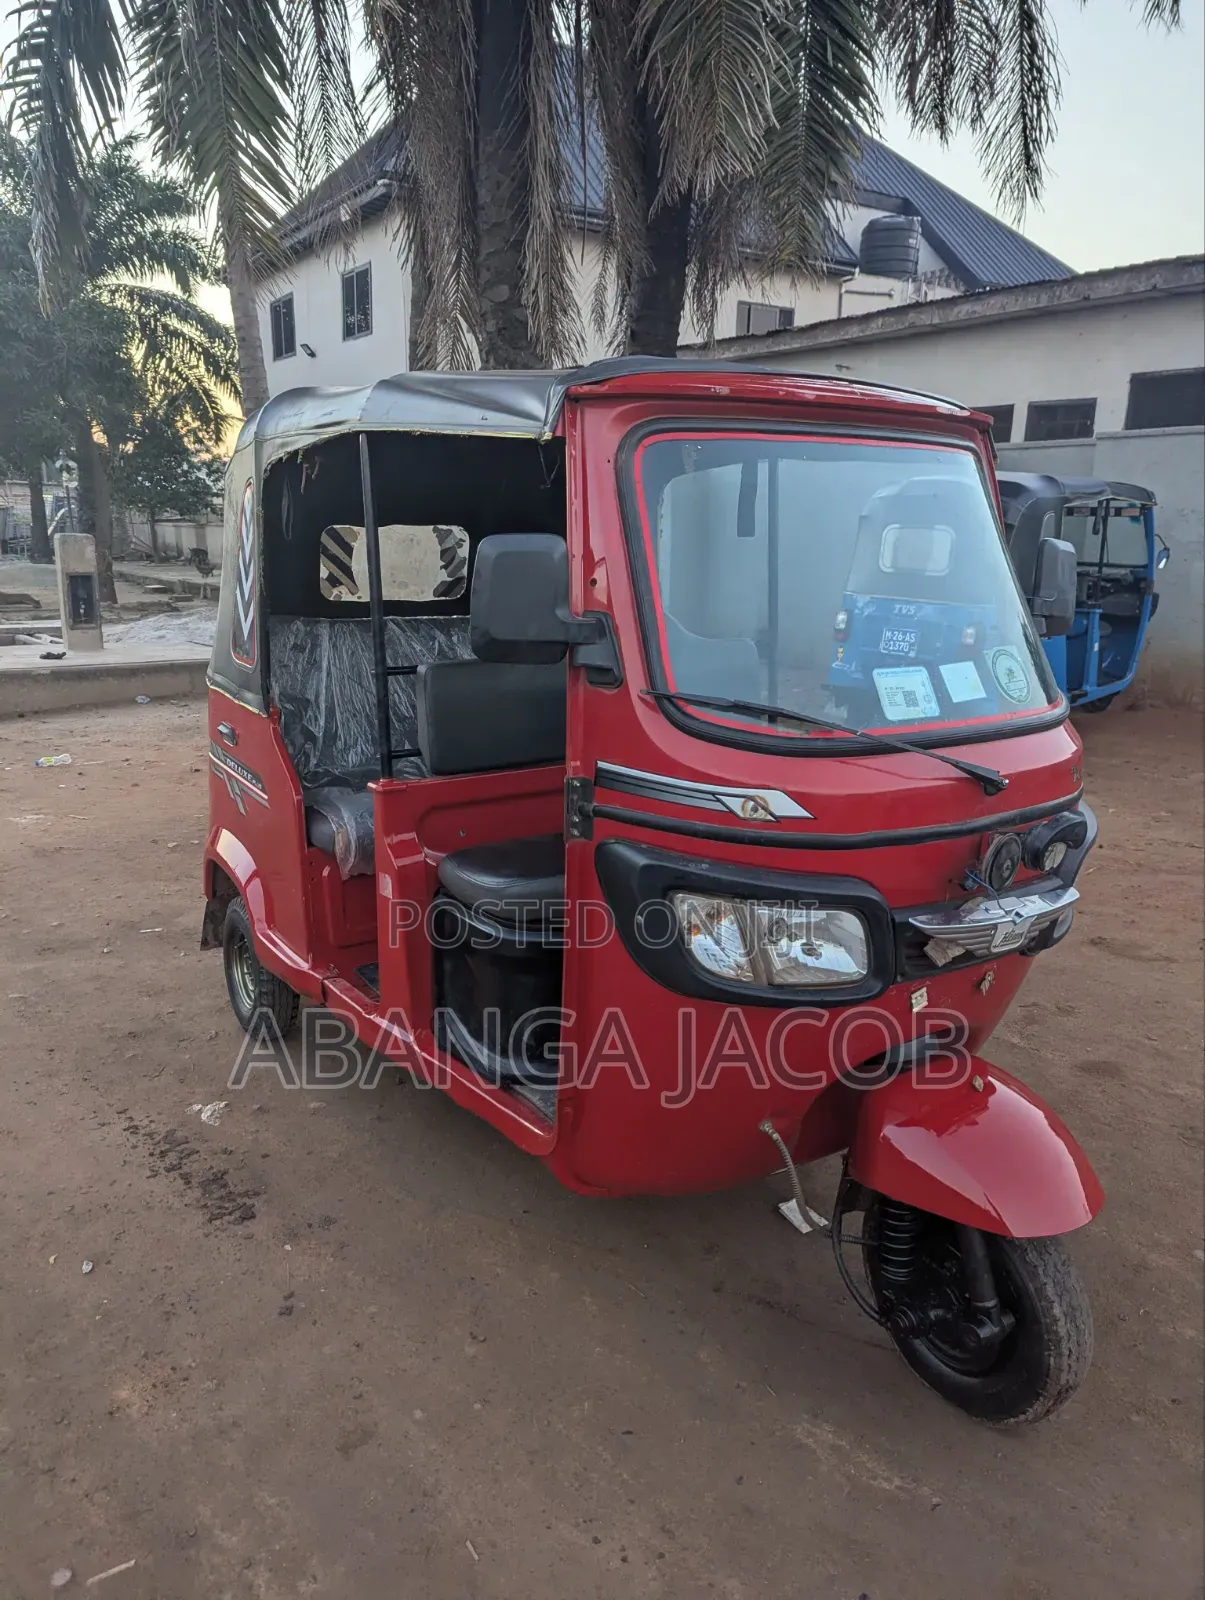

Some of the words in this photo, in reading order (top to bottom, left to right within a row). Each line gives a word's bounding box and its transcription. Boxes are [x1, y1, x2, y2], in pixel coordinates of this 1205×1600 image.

[893, 604, 916, 615] TVS
[885, 631, 916, 643] M-26-AS
[889, 641, 910, 651] 1370
[227, 758, 252, 781] DELUXE
